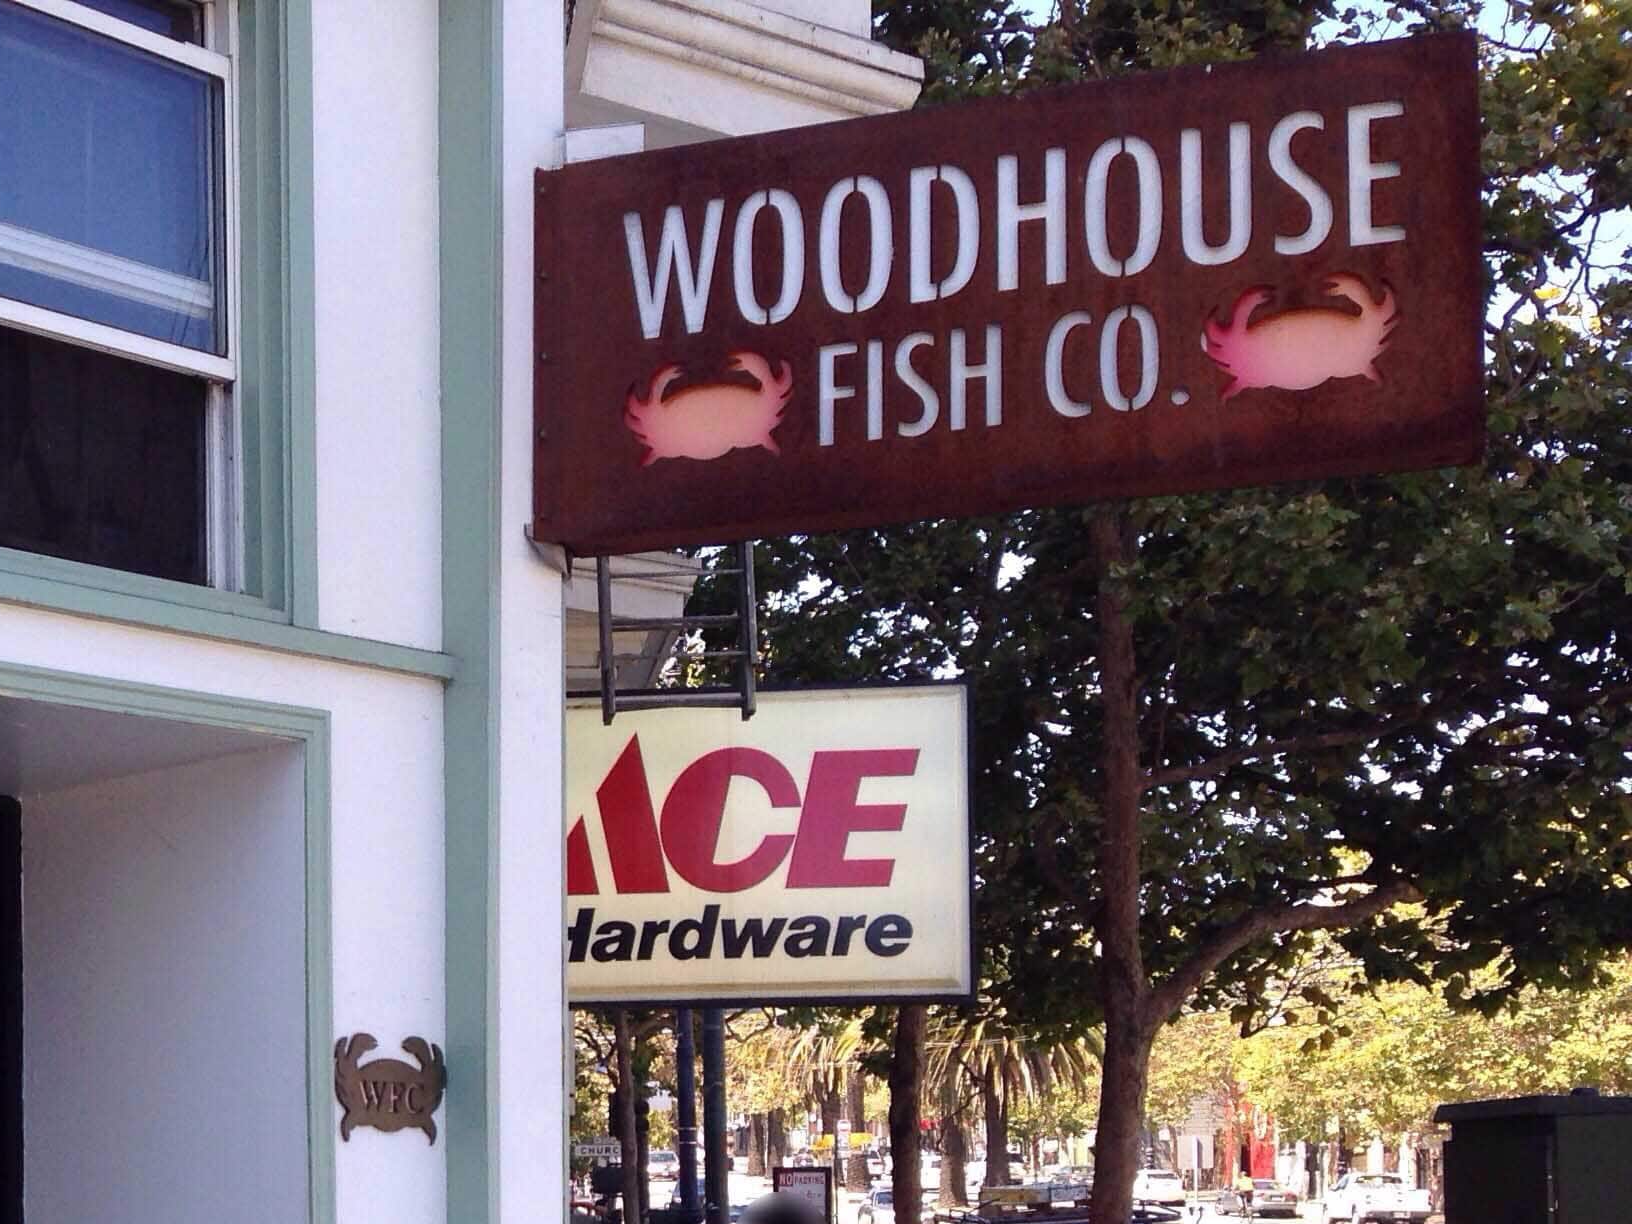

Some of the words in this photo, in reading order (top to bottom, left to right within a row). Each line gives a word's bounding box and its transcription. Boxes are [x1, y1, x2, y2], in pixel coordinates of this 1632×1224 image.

[622, 100, 1407, 340] WOODHOUSE
[817, 323, 1003, 447] FISH
[1044, 304, 1191, 419] CO.
[567, 732, 921, 896] ACE
[580, 1146, 620, 1155] CHURC
[779, 1172, 793, 1185] NO
[795, 1174, 825, 1185] PARKING
